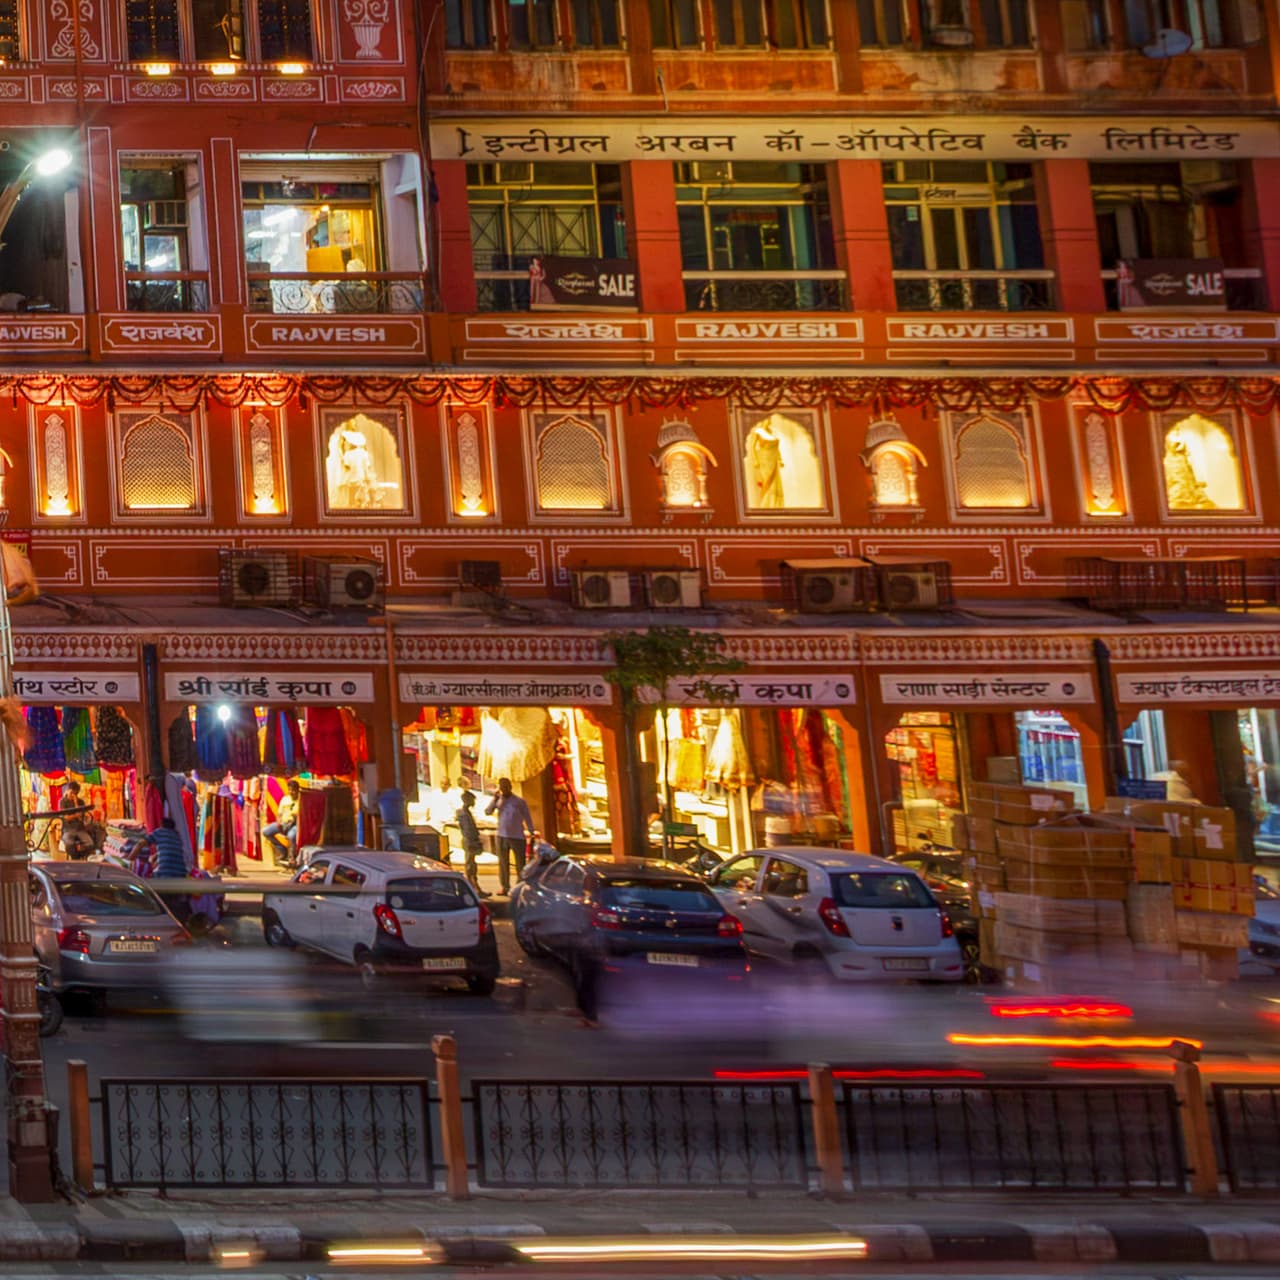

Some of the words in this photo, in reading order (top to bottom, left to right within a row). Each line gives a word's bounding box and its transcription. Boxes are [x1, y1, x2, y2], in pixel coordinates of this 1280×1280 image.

[635, 134, 737, 153] अरबन
[1012, 124, 1071, 151] बैंक
[1100, 124, 1240, 151] लिमिटेड
[598, 274, 635, 297] SALE
[1185, 272, 1223, 296] SALE
[120, 324, 204, 342] राजवेश
[271, 327, 386, 342] RAJVESH
[695, 323, 838, 338] RAJVESH
[903, 323, 1049, 338] RAJVESH
[48, 676, 99, 696] स्टोर
[178, 676, 213, 696] श्री
[896, 682, 939, 697] राणा
[942, 678, 988, 699] साड़ी
